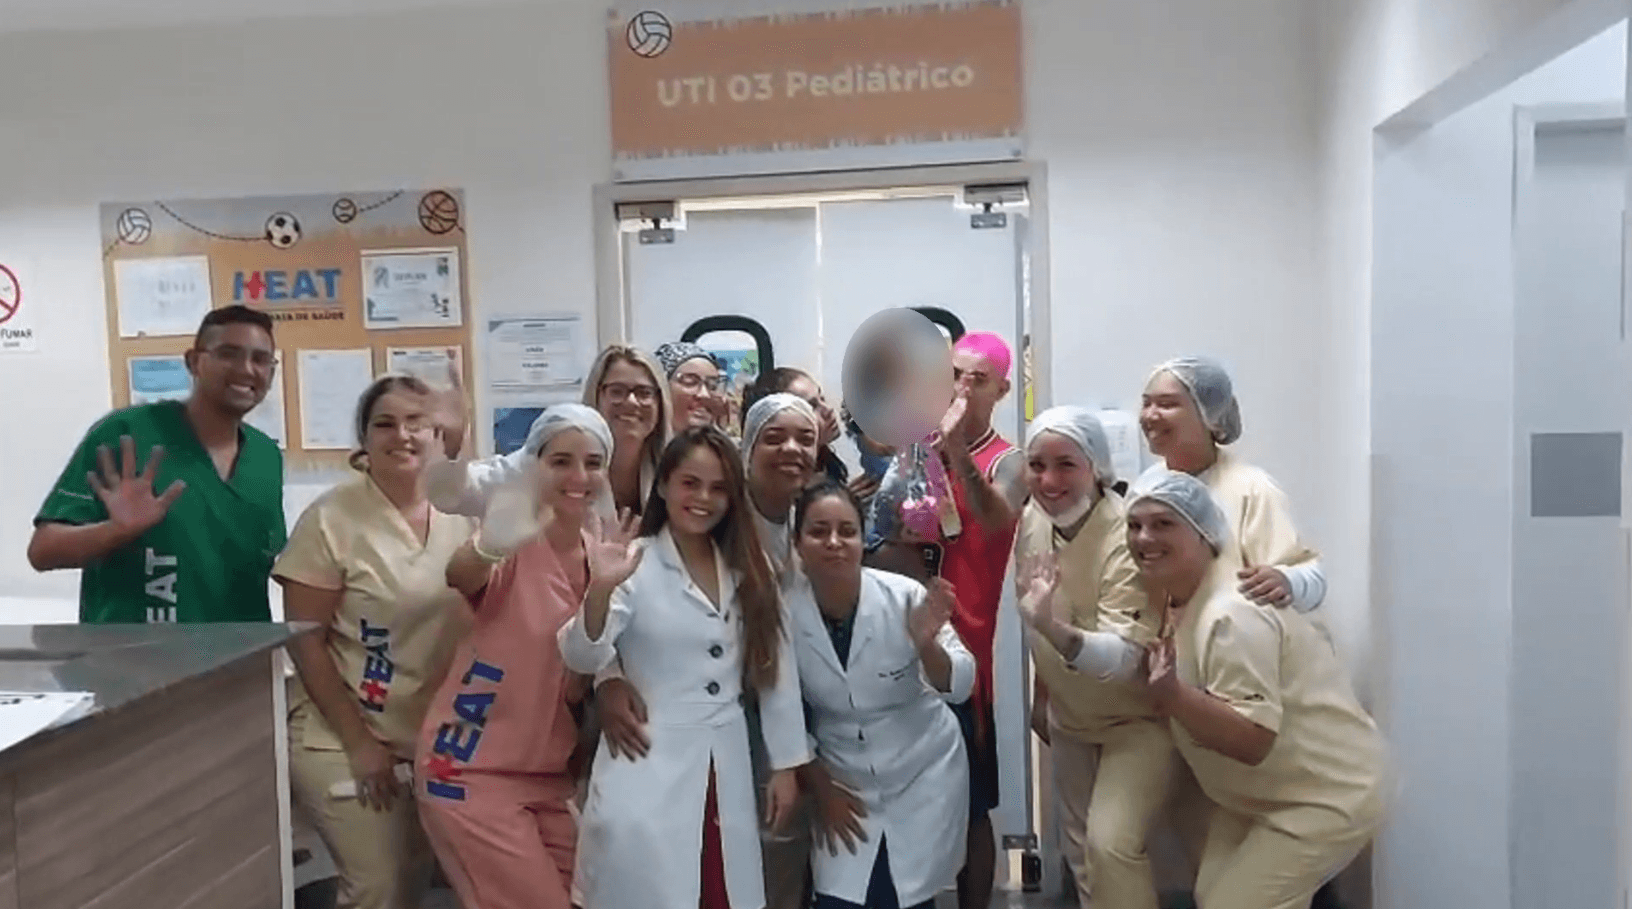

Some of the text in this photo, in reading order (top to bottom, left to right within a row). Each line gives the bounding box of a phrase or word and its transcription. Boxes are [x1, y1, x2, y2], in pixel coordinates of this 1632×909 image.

[656, 60, 975, 106] UTI 03 Pediátrico
[233, 268, 342, 301] HEAT
[0, 328, 33, 339] FUMAR
[145, 547, 177, 623] EAT
[426, 659, 505, 802] HEAT
